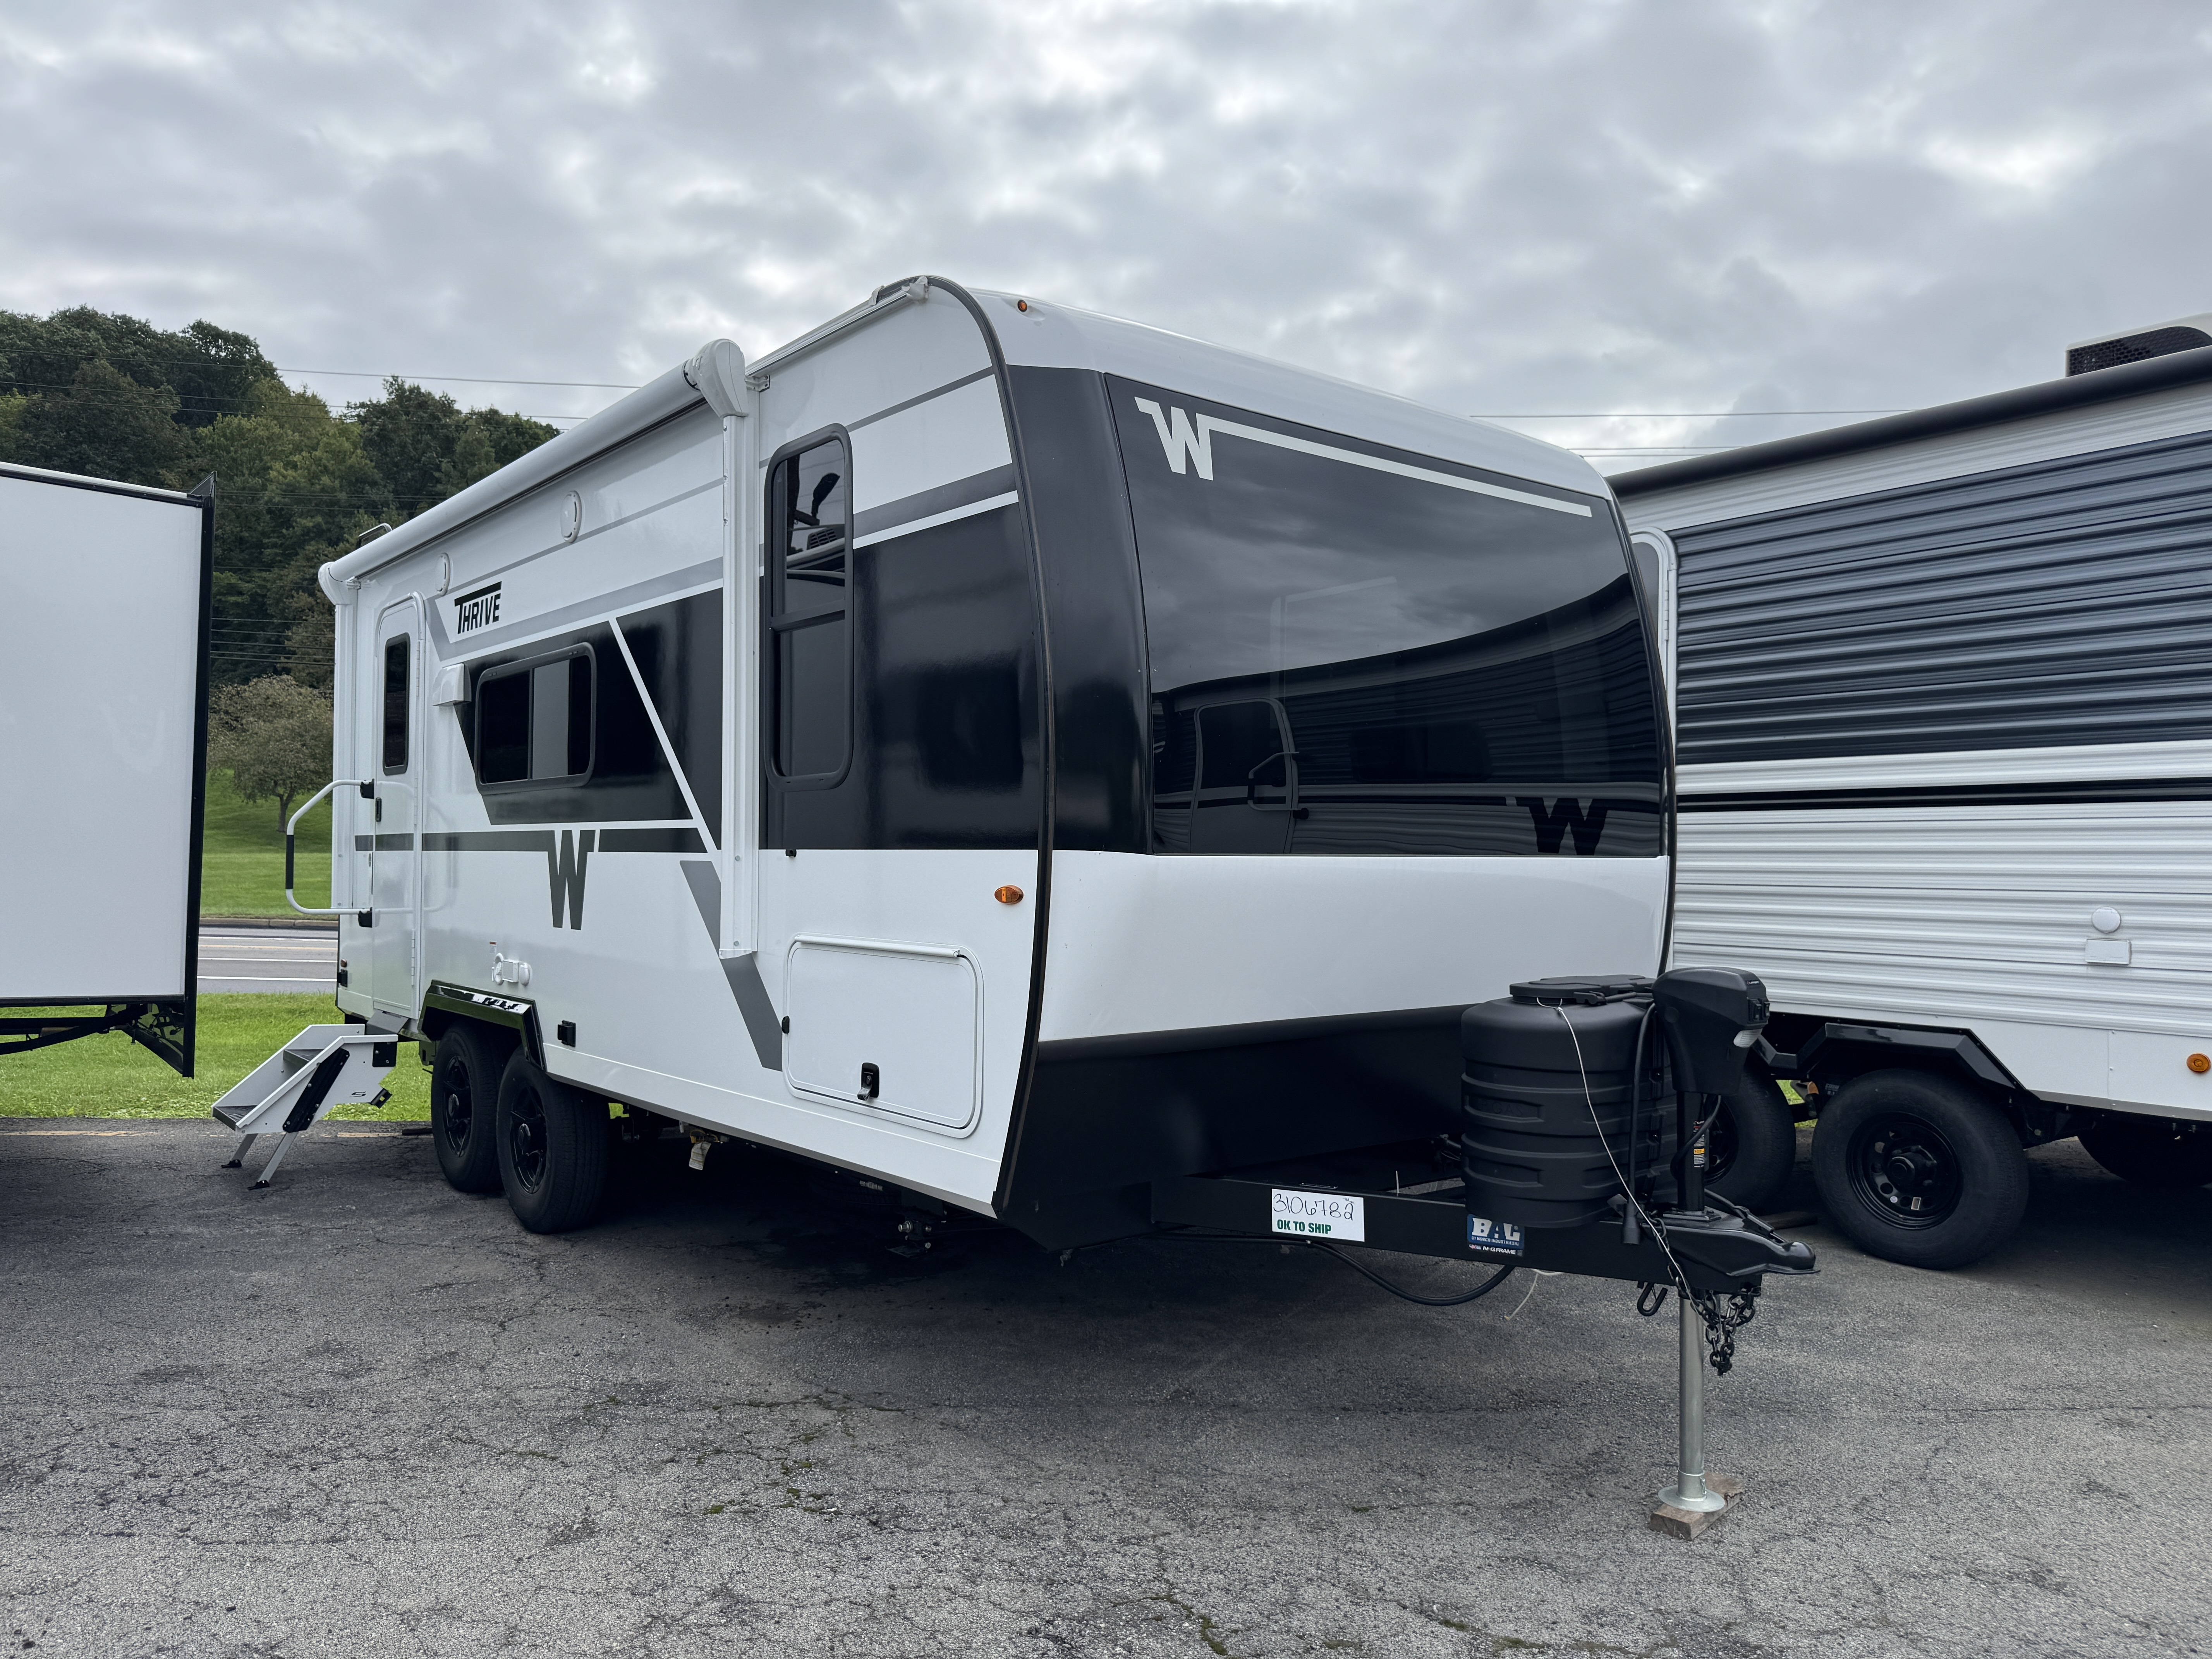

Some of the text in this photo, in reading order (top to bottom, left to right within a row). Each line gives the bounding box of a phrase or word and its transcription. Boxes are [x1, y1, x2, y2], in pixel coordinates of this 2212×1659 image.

[1134, 397, 1213, 481] W
[454, 581, 502, 634] THRIVE
[1515, 797, 1608, 855] W
[547, 830, 596, 930] W
[1492, 1101, 1522, 1117] GAS
[1273, 1193, 1353, 1221] 3106782
[1277, 1219, 1332, 1234] OK TO SHIP
[1472, 1218, 1520, 1242] BAL
